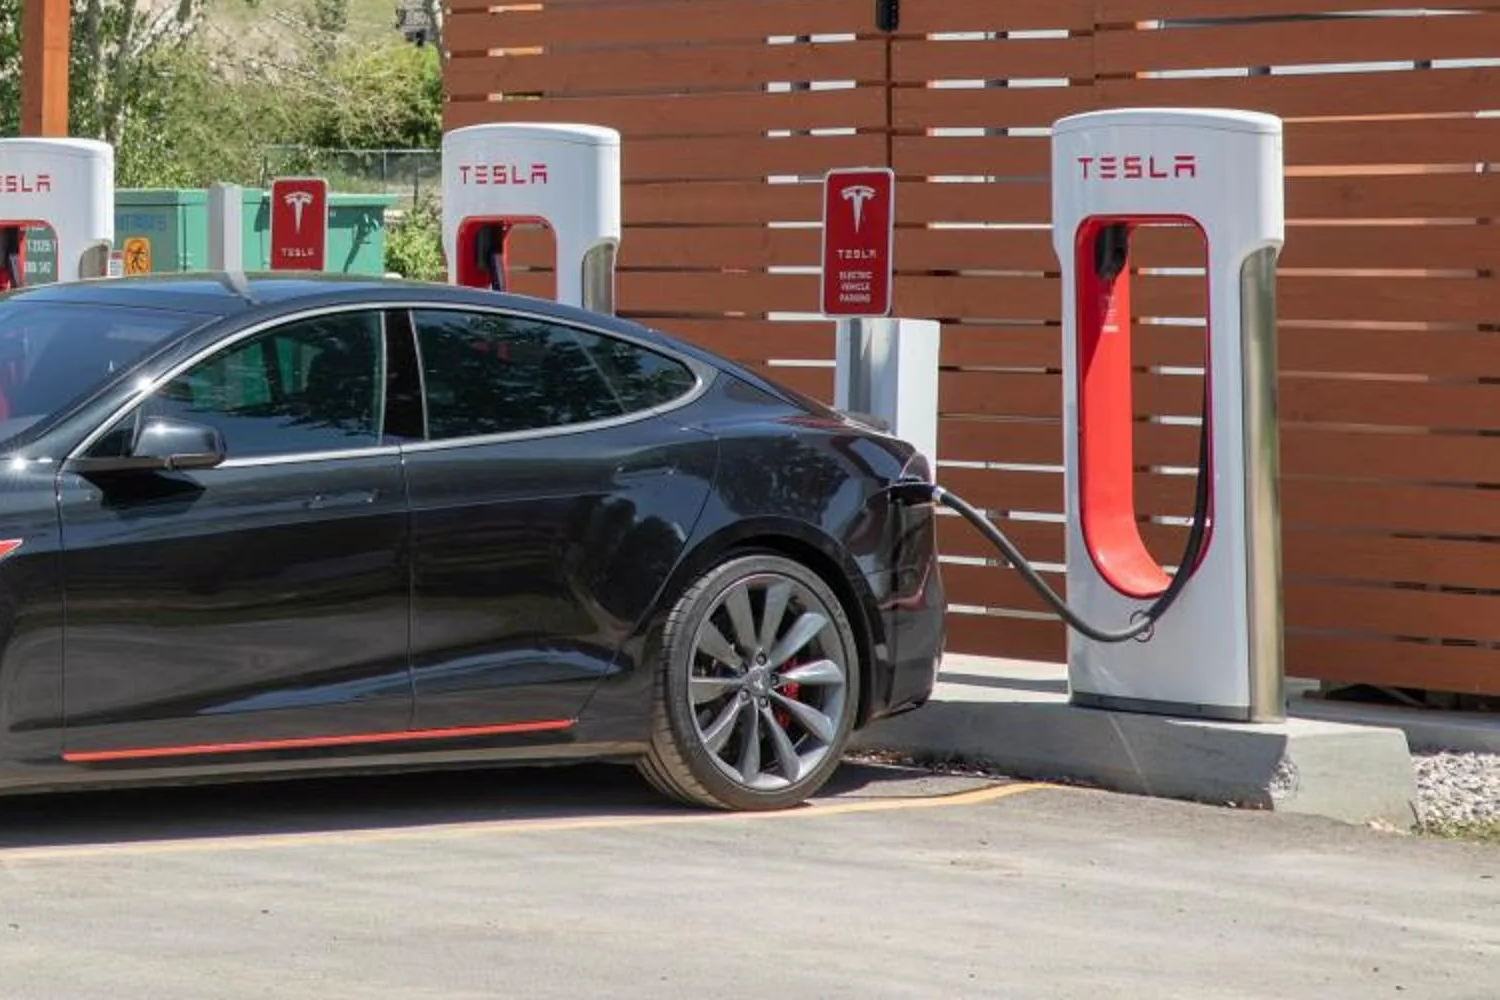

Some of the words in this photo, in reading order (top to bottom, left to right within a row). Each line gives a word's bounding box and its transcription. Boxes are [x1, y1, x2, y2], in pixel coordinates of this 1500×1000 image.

[458, 164, 548, 185] TESLA
[1077, 155, 1195, 180] TESLA
[281, 247, 315, 257] TESLA
[836, 249, 877, 260] TESLA
